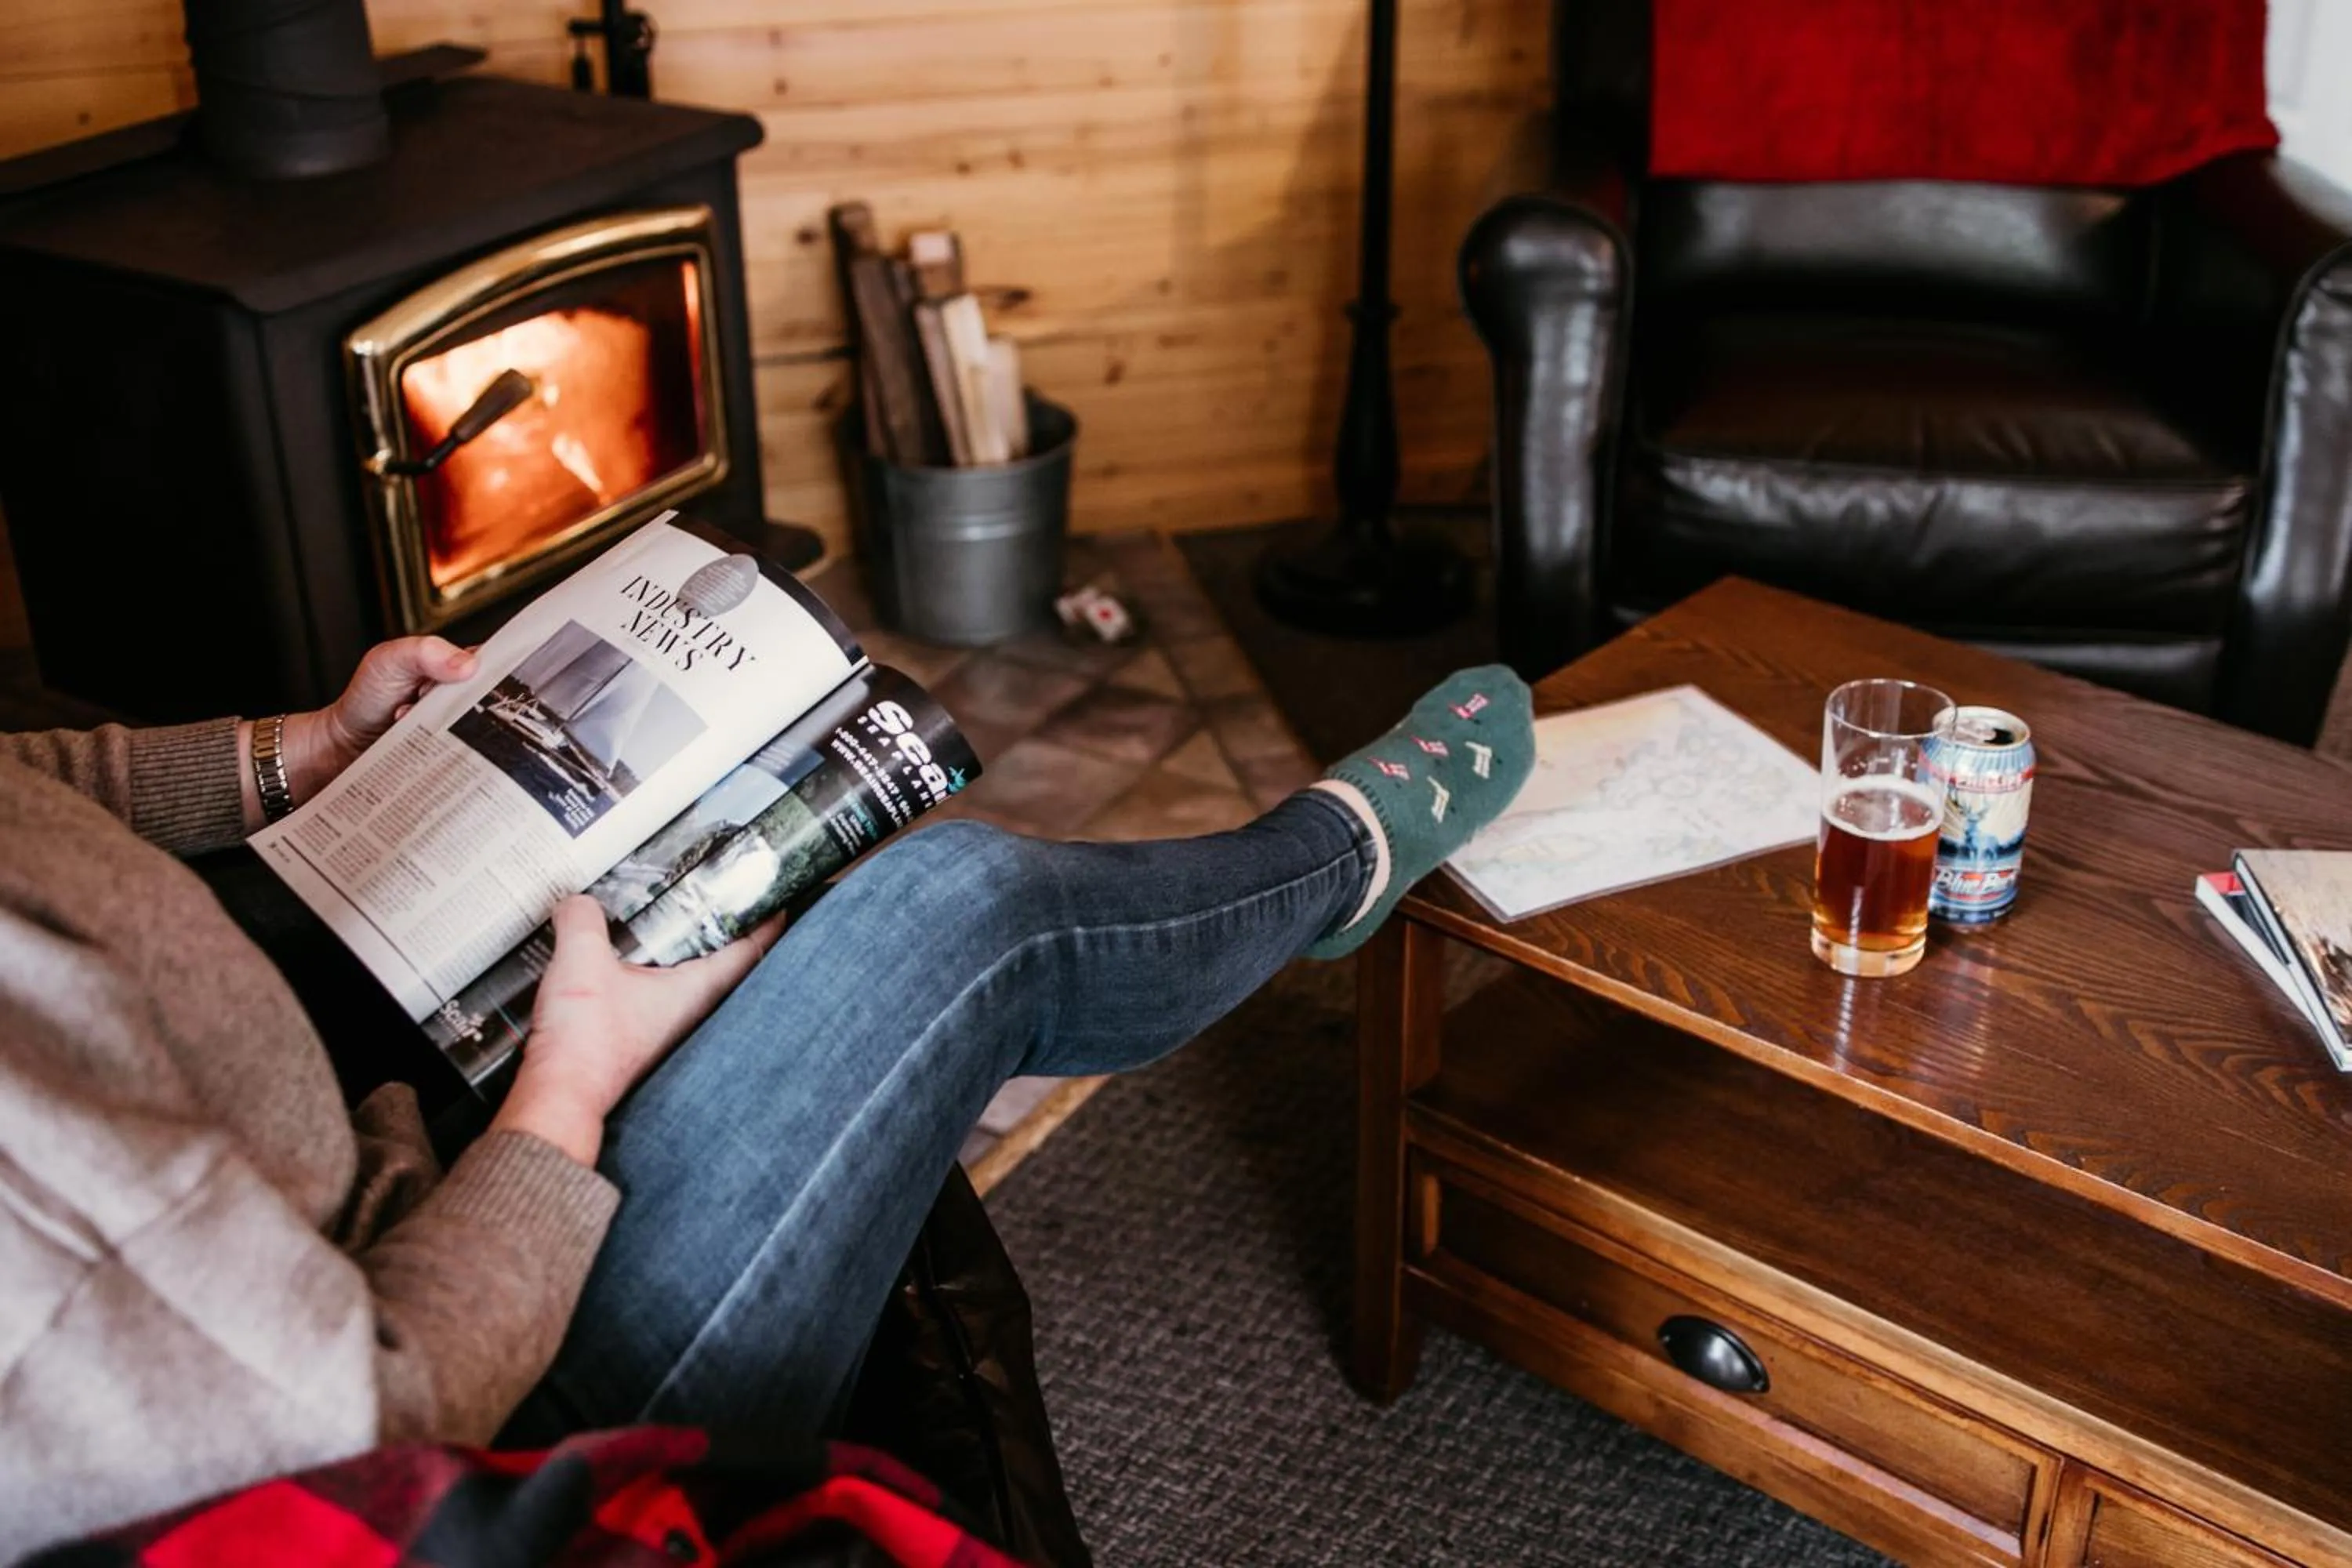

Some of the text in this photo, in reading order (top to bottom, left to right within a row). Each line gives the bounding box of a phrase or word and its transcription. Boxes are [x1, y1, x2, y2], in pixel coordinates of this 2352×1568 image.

[620, 575, 756, 671] INDUSTRY
[620, 609, 704, 671] NEWS
[867, 700, 948, 801] Sea
